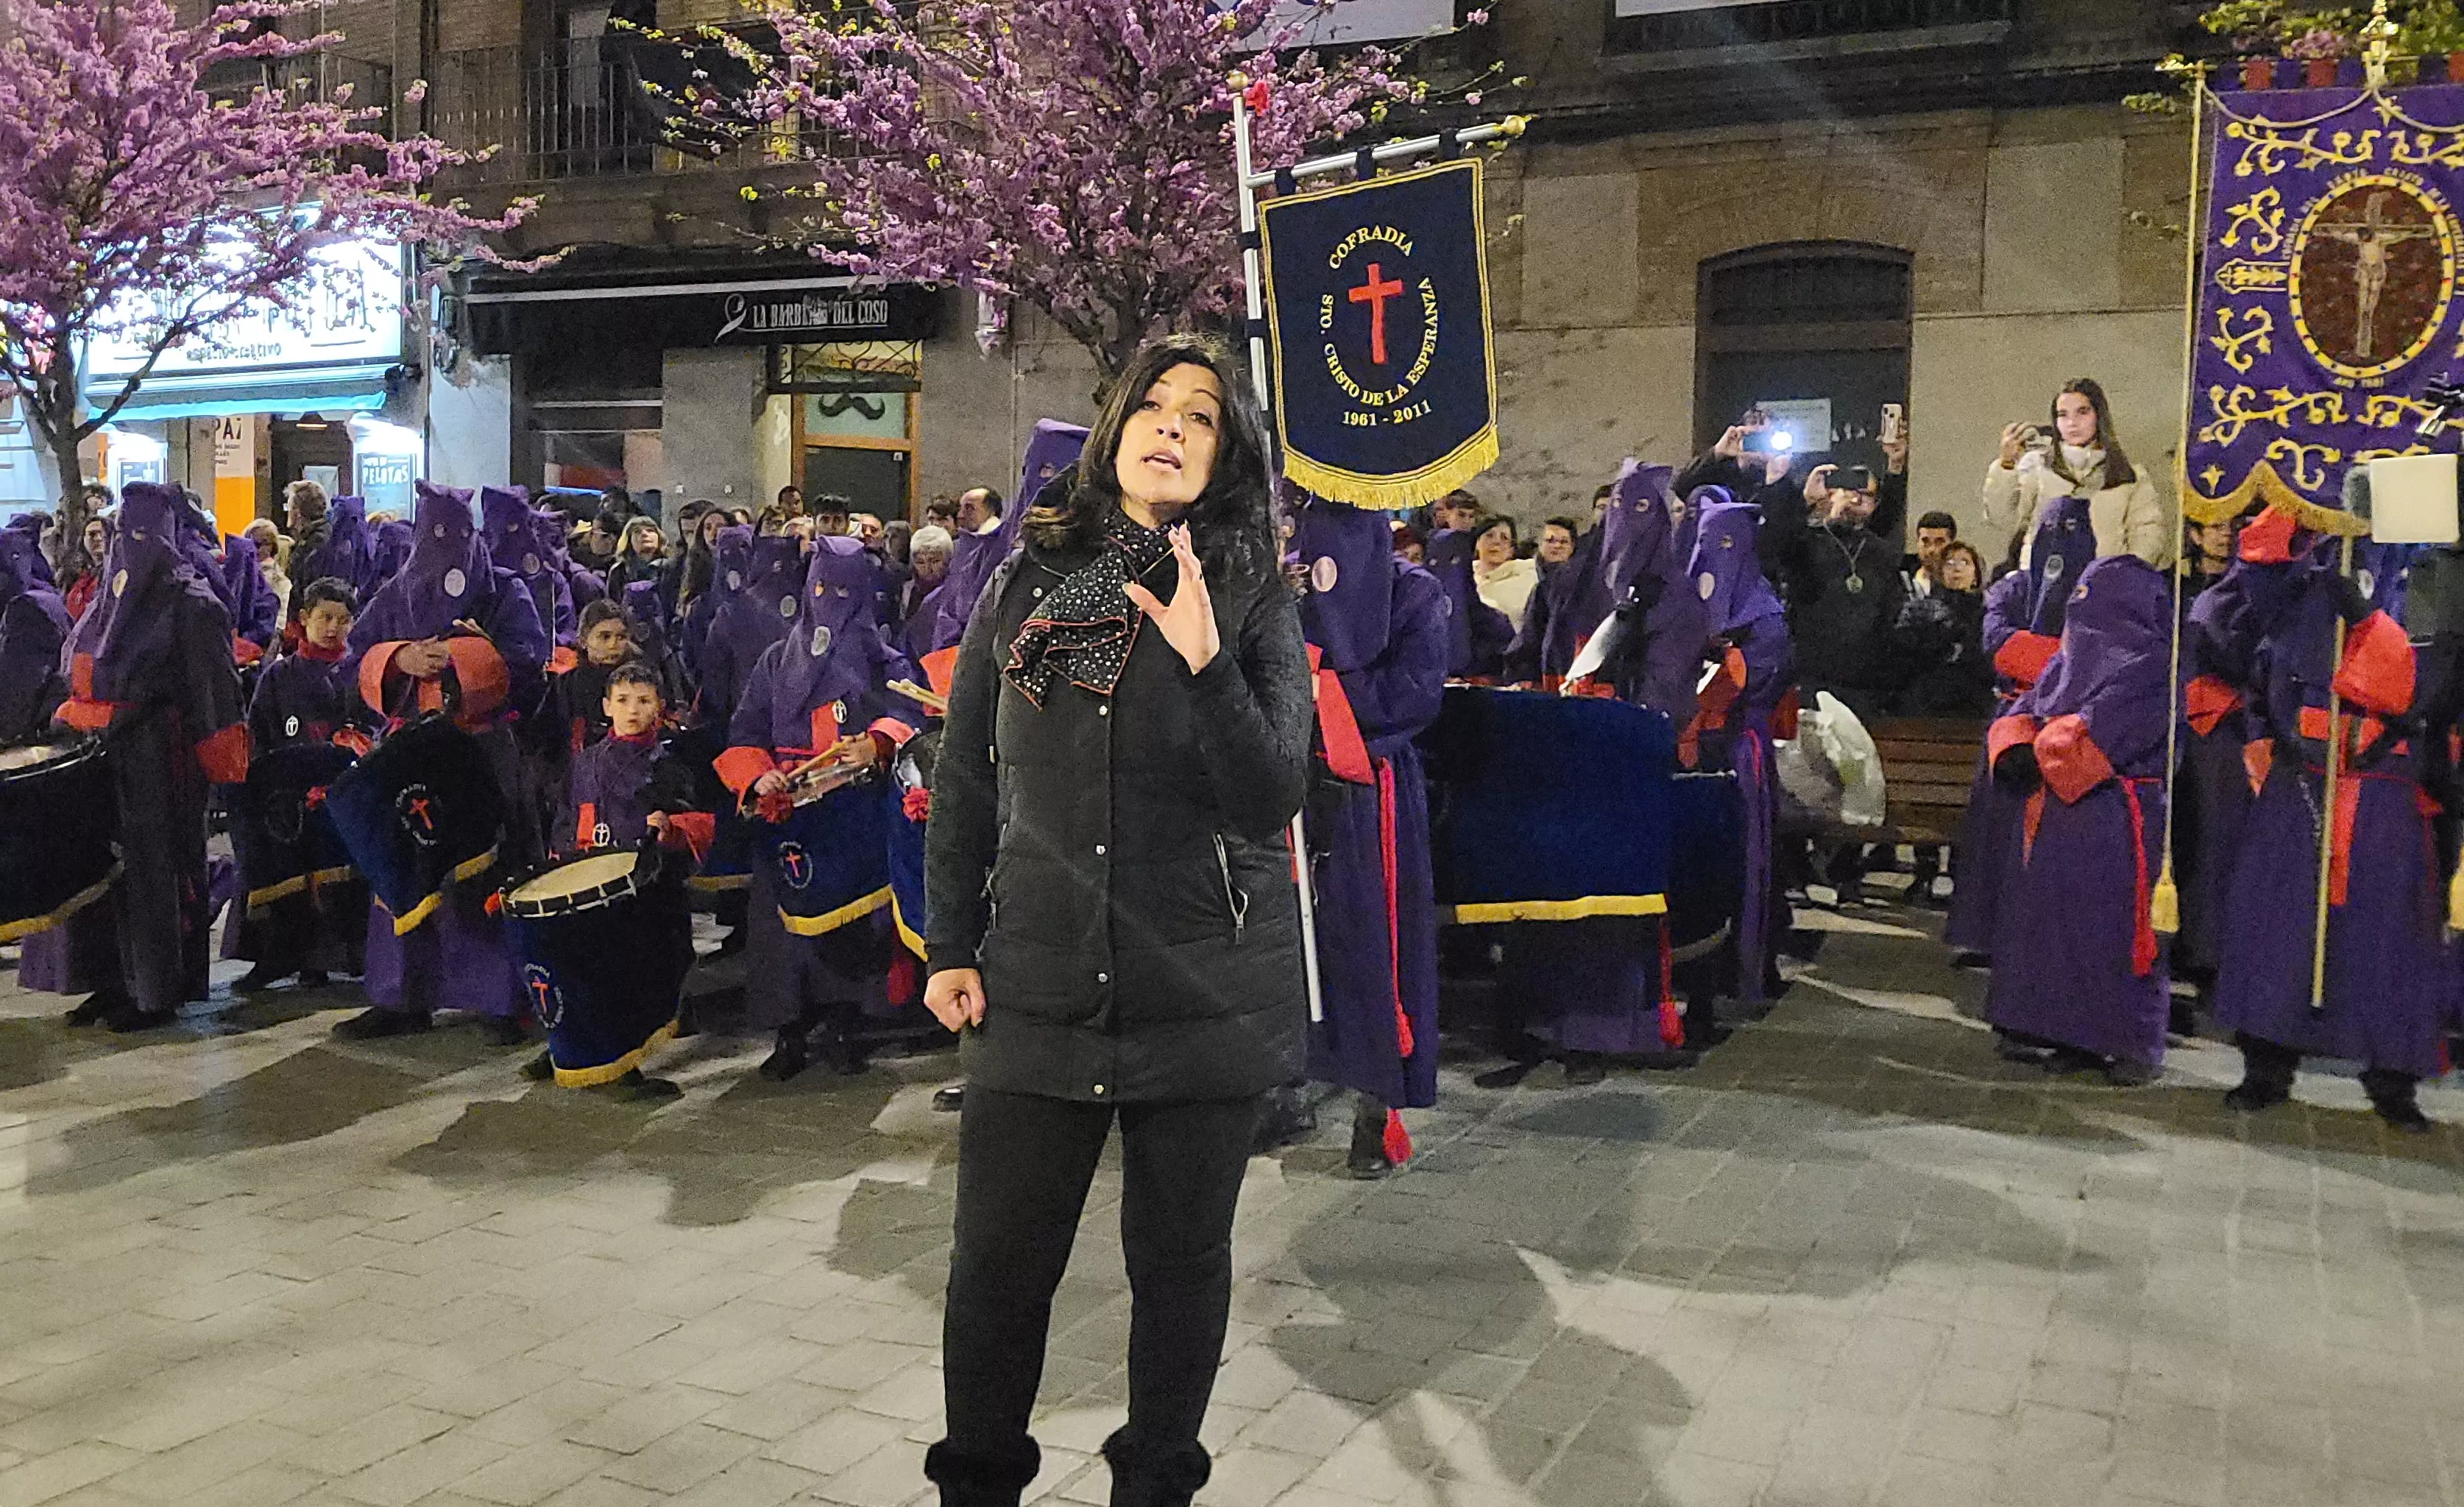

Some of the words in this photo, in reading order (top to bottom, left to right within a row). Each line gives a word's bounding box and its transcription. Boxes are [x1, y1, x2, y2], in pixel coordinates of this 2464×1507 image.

[1328, 224, 1413, 269] COFRADIA
[753, 305, 767, 328] LA
[857, 299, 888, 324] COSO
[1320, 294, 1334, 335] STO.
[1405, 277, 1438, 386] ESPERANZA
[1325, 343, 1360, 398] CRISTO
[1360, 390, 1384, 406] DE
[1385, 383, 1409, 403] LA
[1342, 411, 1377, 426] 1961
[1393, 399, 1431, 424] 2011
[363, 464, 408, 485] PELOTAS
